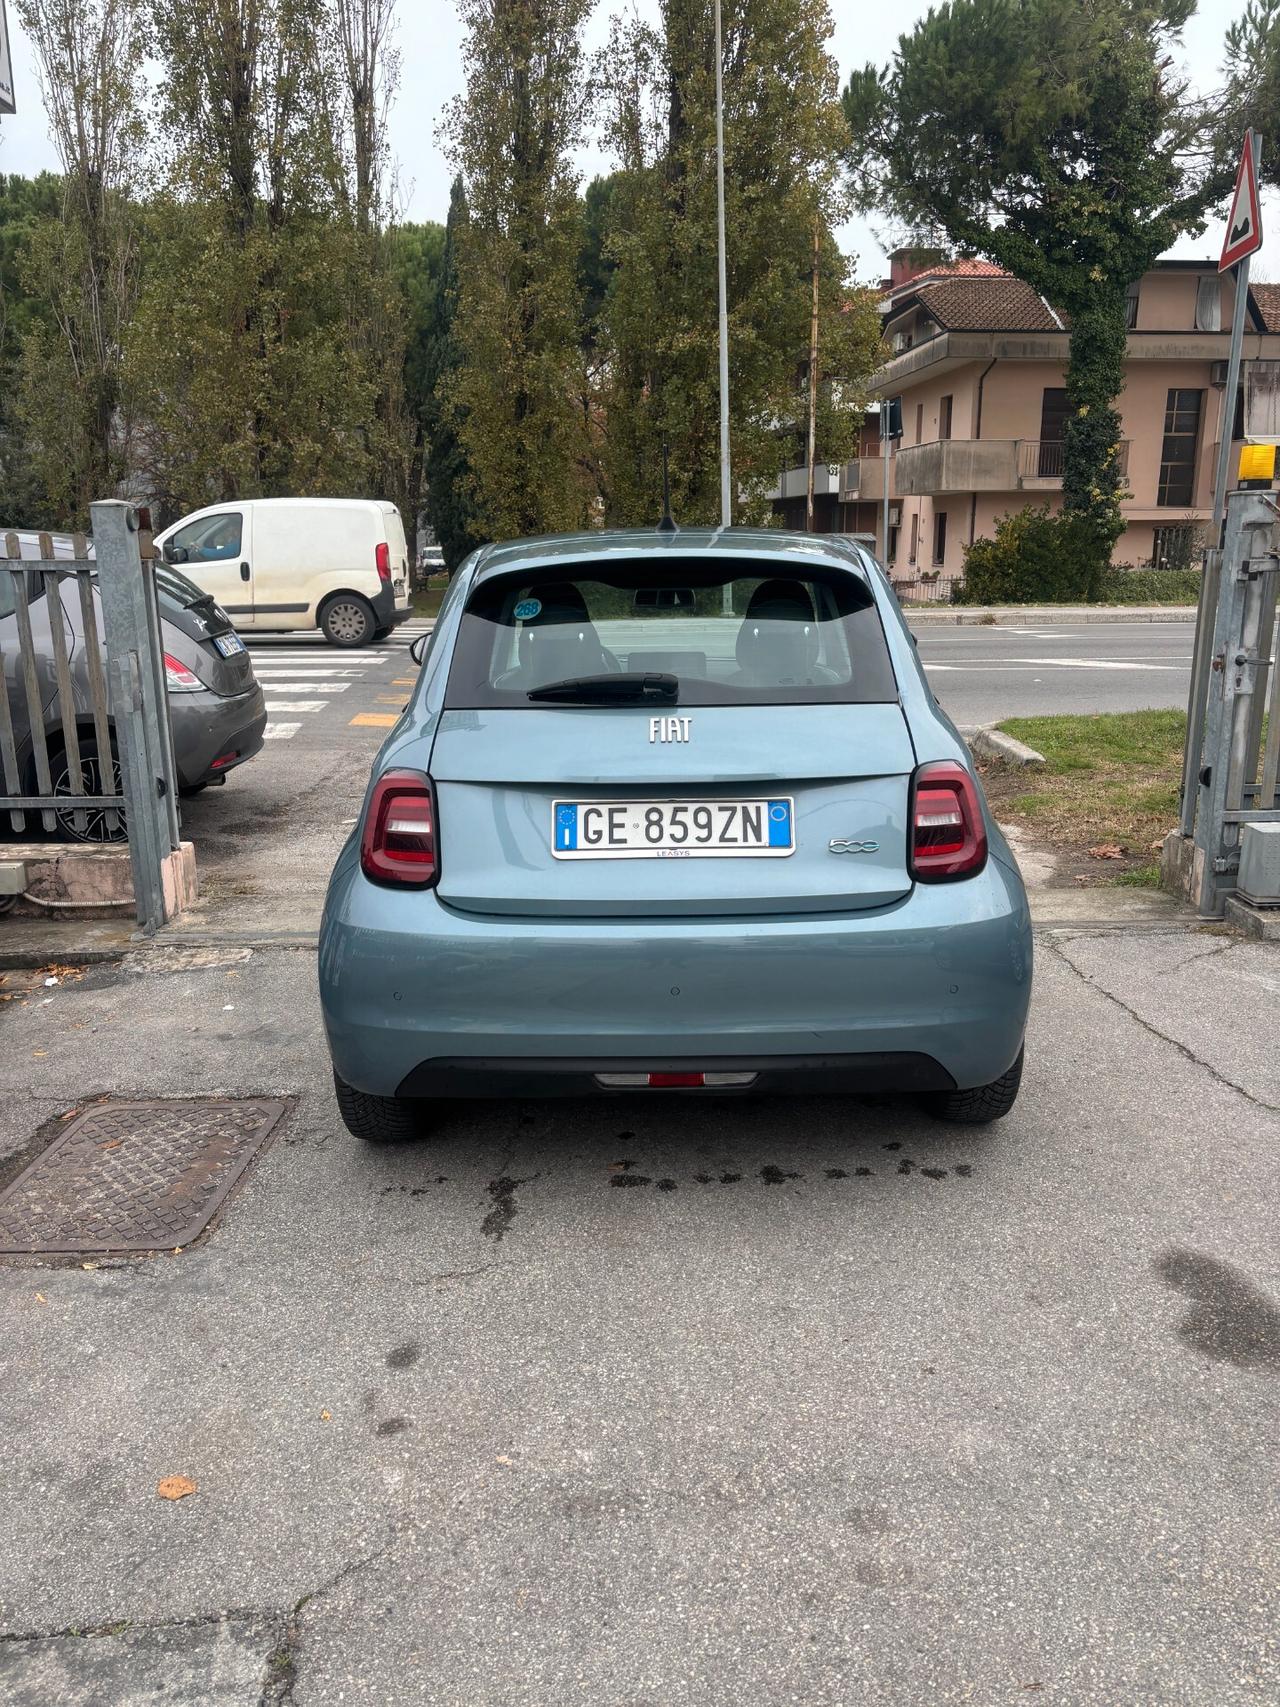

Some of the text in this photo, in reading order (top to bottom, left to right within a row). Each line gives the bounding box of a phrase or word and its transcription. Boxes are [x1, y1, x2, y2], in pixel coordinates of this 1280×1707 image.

[516, 602, 539, 616] 268
[649, 717, 692, 744] FIAT
[583, 807, 628, 844] GE
[644, 805, 763, 844] 859ZN
